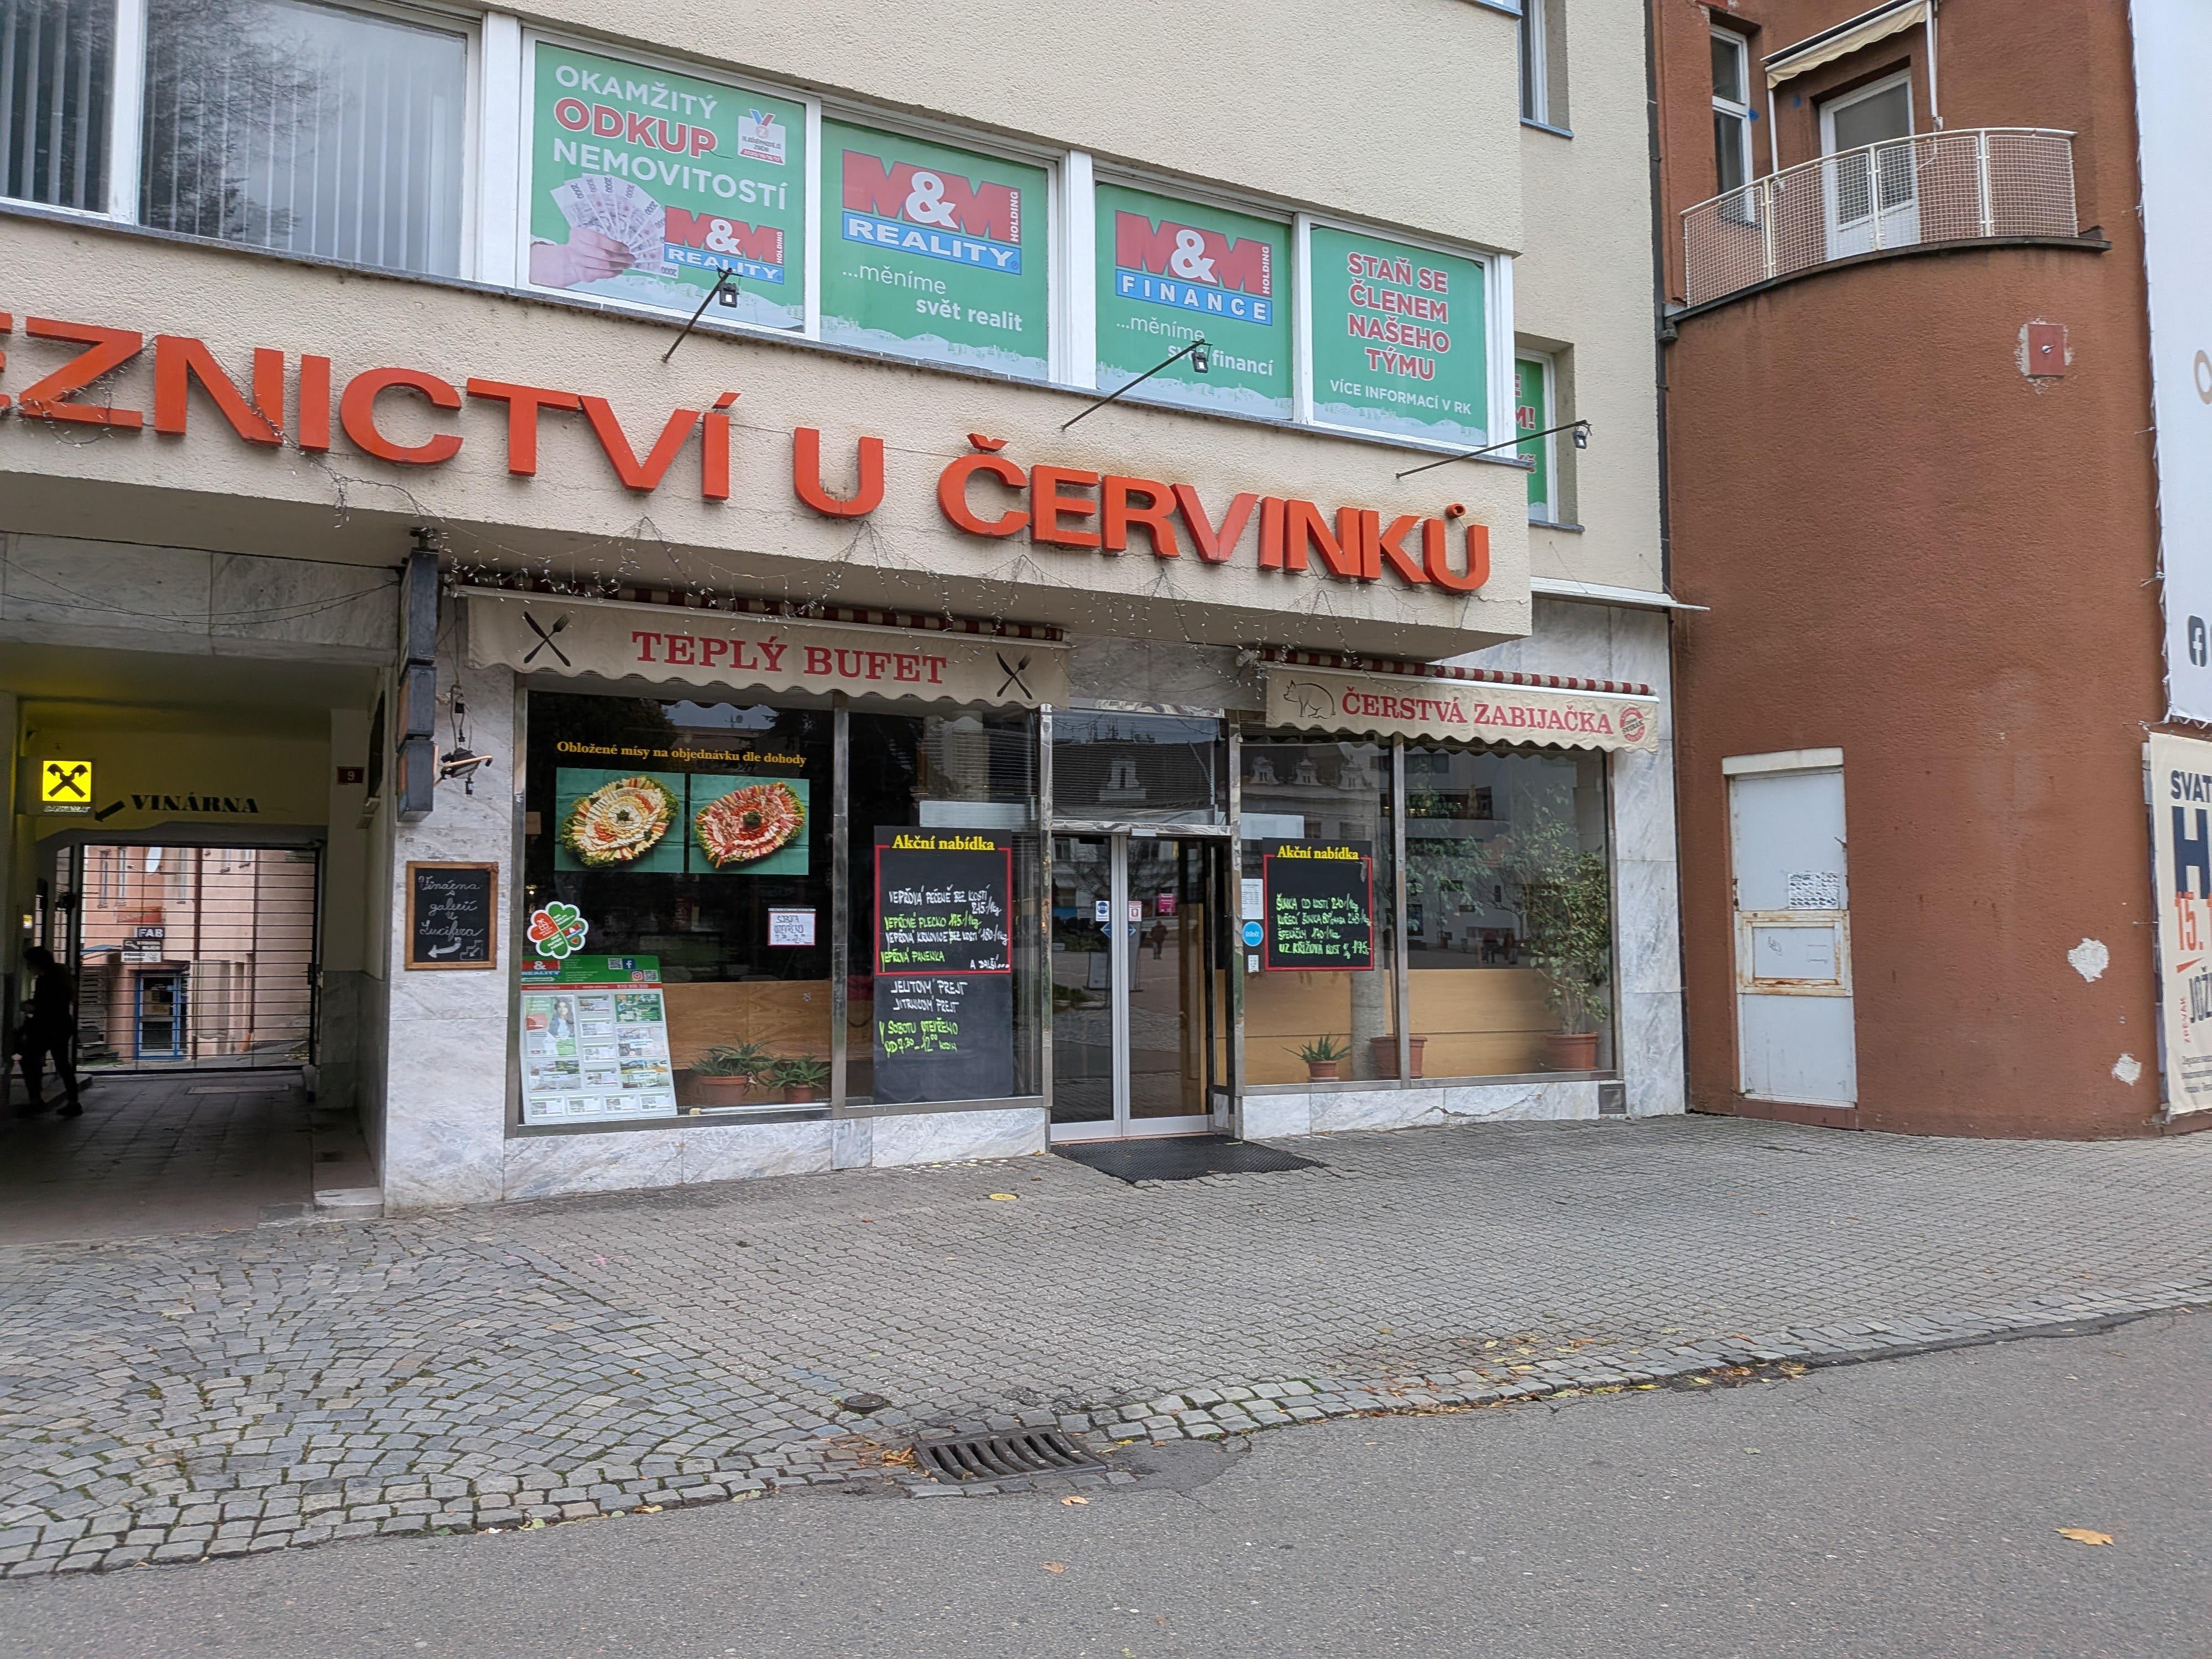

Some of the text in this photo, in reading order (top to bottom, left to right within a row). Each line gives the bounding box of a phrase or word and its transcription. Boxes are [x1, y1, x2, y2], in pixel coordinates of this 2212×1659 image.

[555, 65, 717, 119] OKAMŽITÝ
[554, 98, 718, 159] ODKUP
[554, 139, 786, 210] NEMOVITOSTÍ
[842, 149, 1021, 245] M&M
[1010, 191, 1019, 243] HOLDING
[665, 206, 784, 264] M&M
[848, 219, 1015, 271] REALITY
[1115, 210, 1272, 296] M&M
[668, 248, 779, 279] REALITY
[842, 264, 946, 295] ...měníme
[1261, 246, 1271, 295] HOLDING
[1347, 252, 1448, 294] STAŇ SE
[916, 295, 1022, 332] svět realit
[1121, 276, 1267, 321] FINANCE
[1348, 282, 1448, 325] ČLENEM
[1348, 312, 1451, 354] NAŠEHO
[1212, 349, 1274, 375] financí
[1365, 346, 1434, 381] TÝMU
[1329, 378, 1472, 415] VÍCE INFORMACÍ V RK
[794, 427, 885, 518] U
[937, 432, 1490, 593] ČERVINKŮ
[632, 630, 947, 685] TEPLÝ BUFET
[1342, 686, 1467, 724] ČERSTVÁ
[1474, 703, 1614, 735] ZABIJAČKA
[557, 741, 807, 767] Obložené mísy na objednávku dle dohody
[131, 791, 259, 813] VINÁRNA
[891, 834, 995, 851] Akční nabídka
[1276, 845, 1359, 860] Akční nabídka
